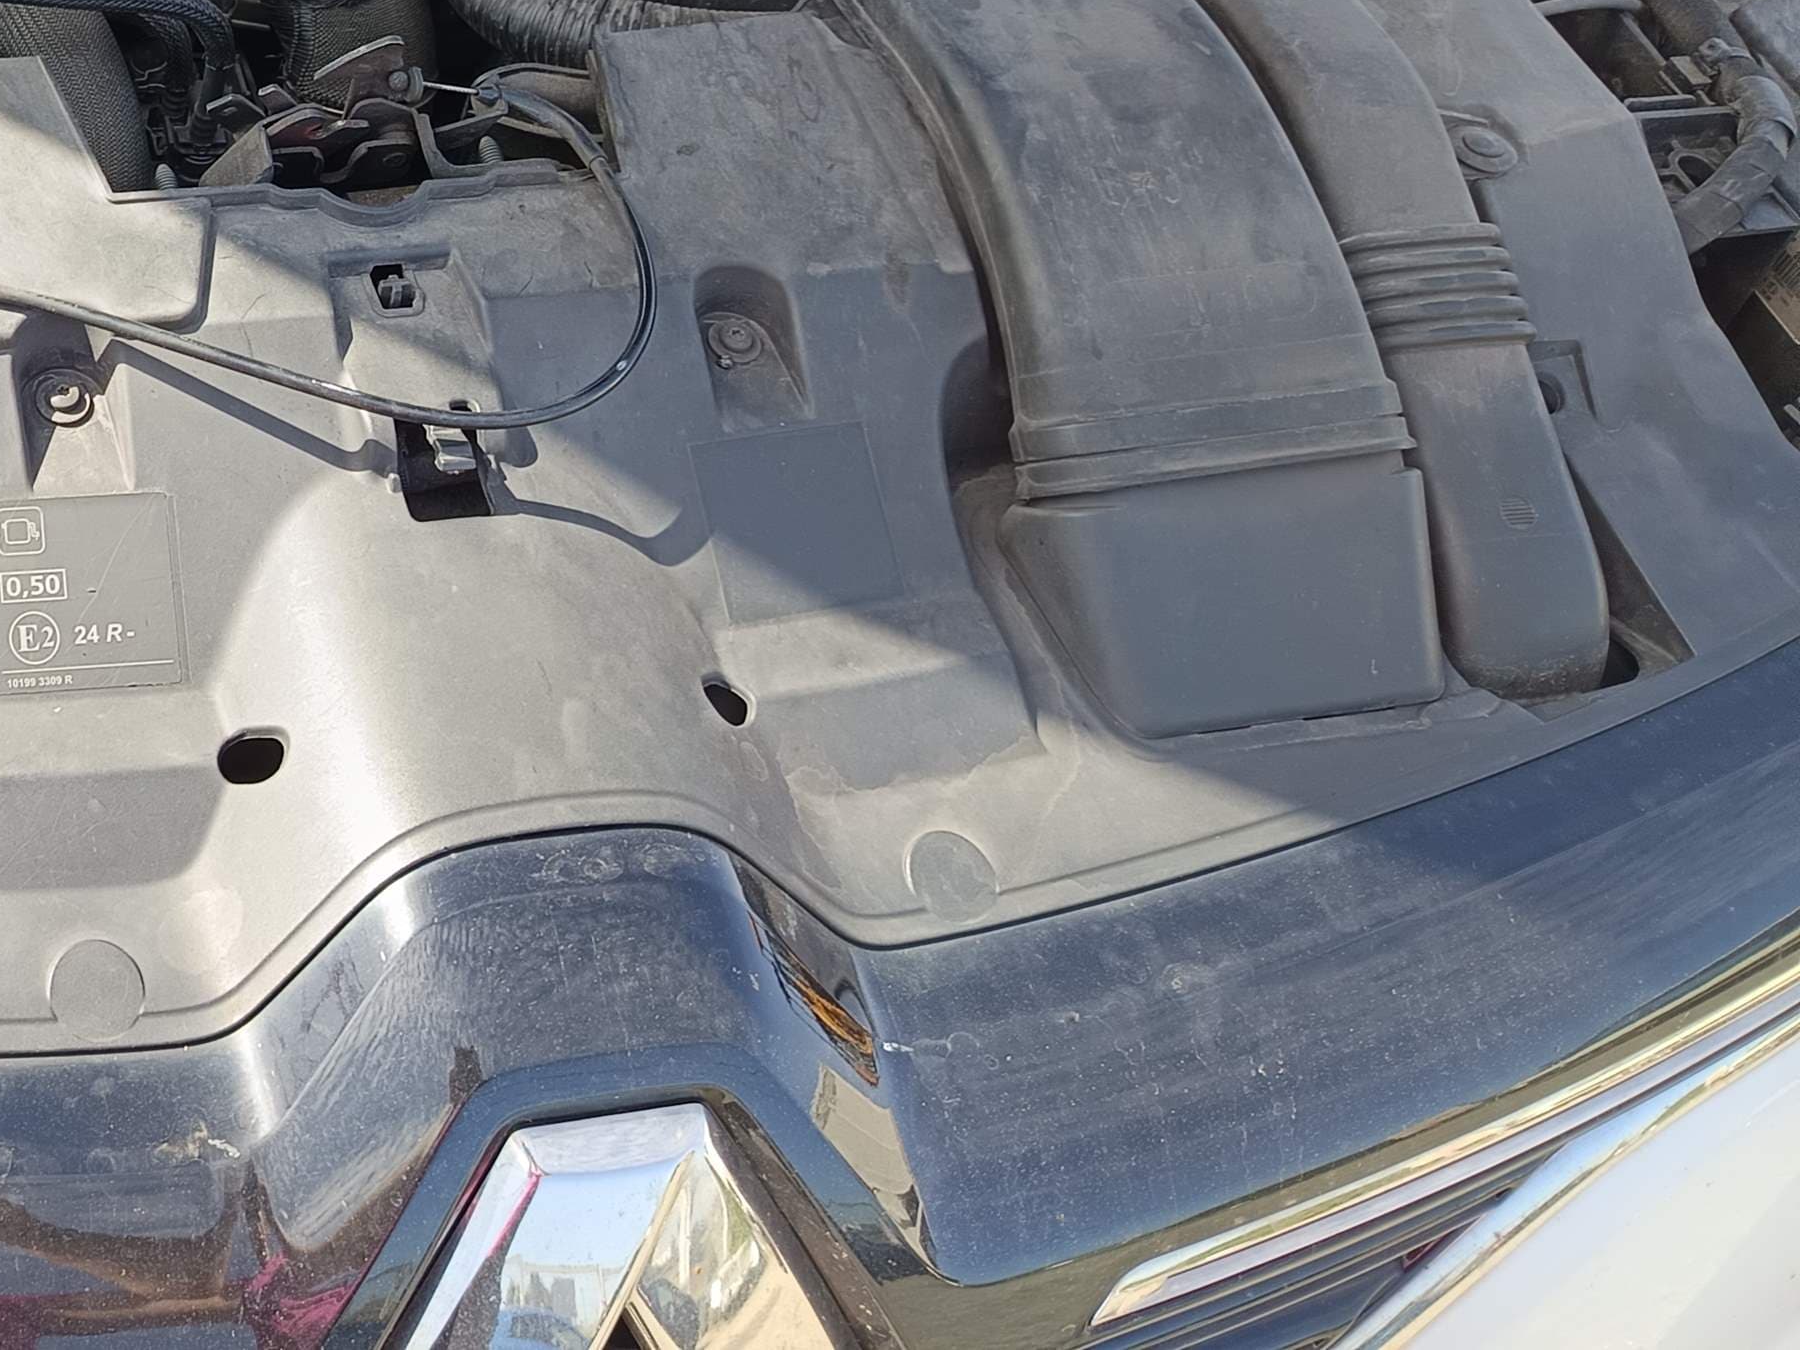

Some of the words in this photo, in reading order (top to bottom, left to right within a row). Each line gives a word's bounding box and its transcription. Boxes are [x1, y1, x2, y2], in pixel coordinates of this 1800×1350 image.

[5, 573, 61, 599] 0,50
[16, 623, 56, 652] E2
[73, 624, 100, 645] 24
[7, 677, 37, 689] 10199
[64, 674, 73, 685] R
